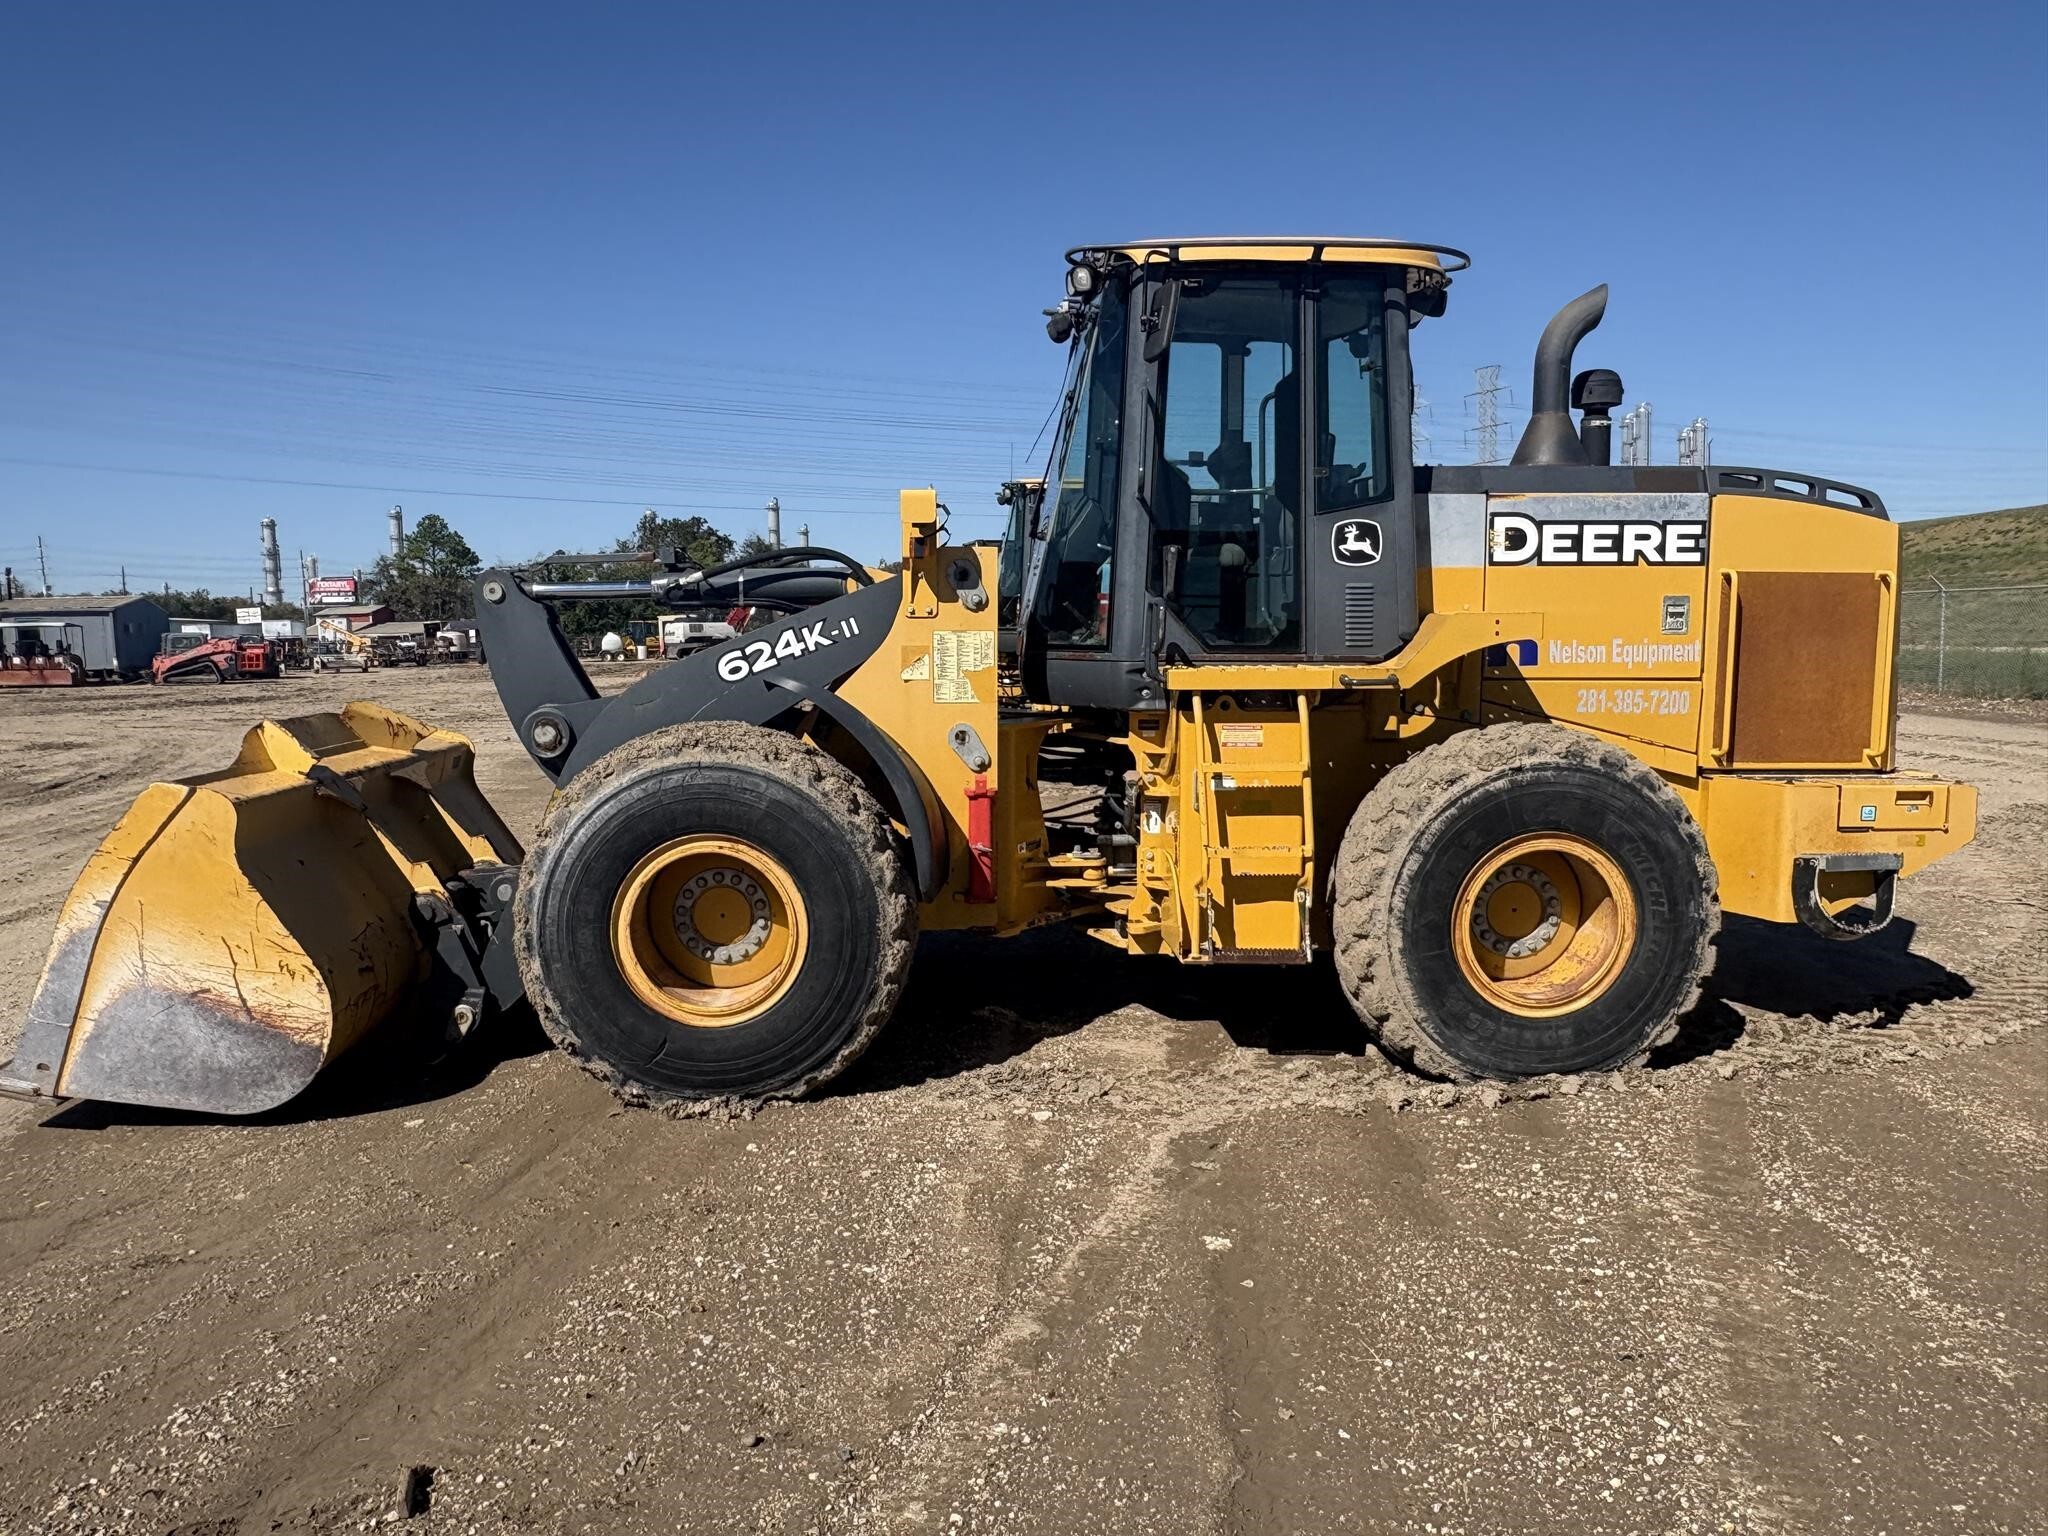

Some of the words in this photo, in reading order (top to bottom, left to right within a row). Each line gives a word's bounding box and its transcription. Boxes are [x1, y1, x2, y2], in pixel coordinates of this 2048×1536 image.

[1491, 515, 1703, 563] DEERE
[1549, 639, 1606, 664] Nelson
[1612, 637, 1701, 669] Equipment
[1576, 687, 1691, 715] 281-385-7200
